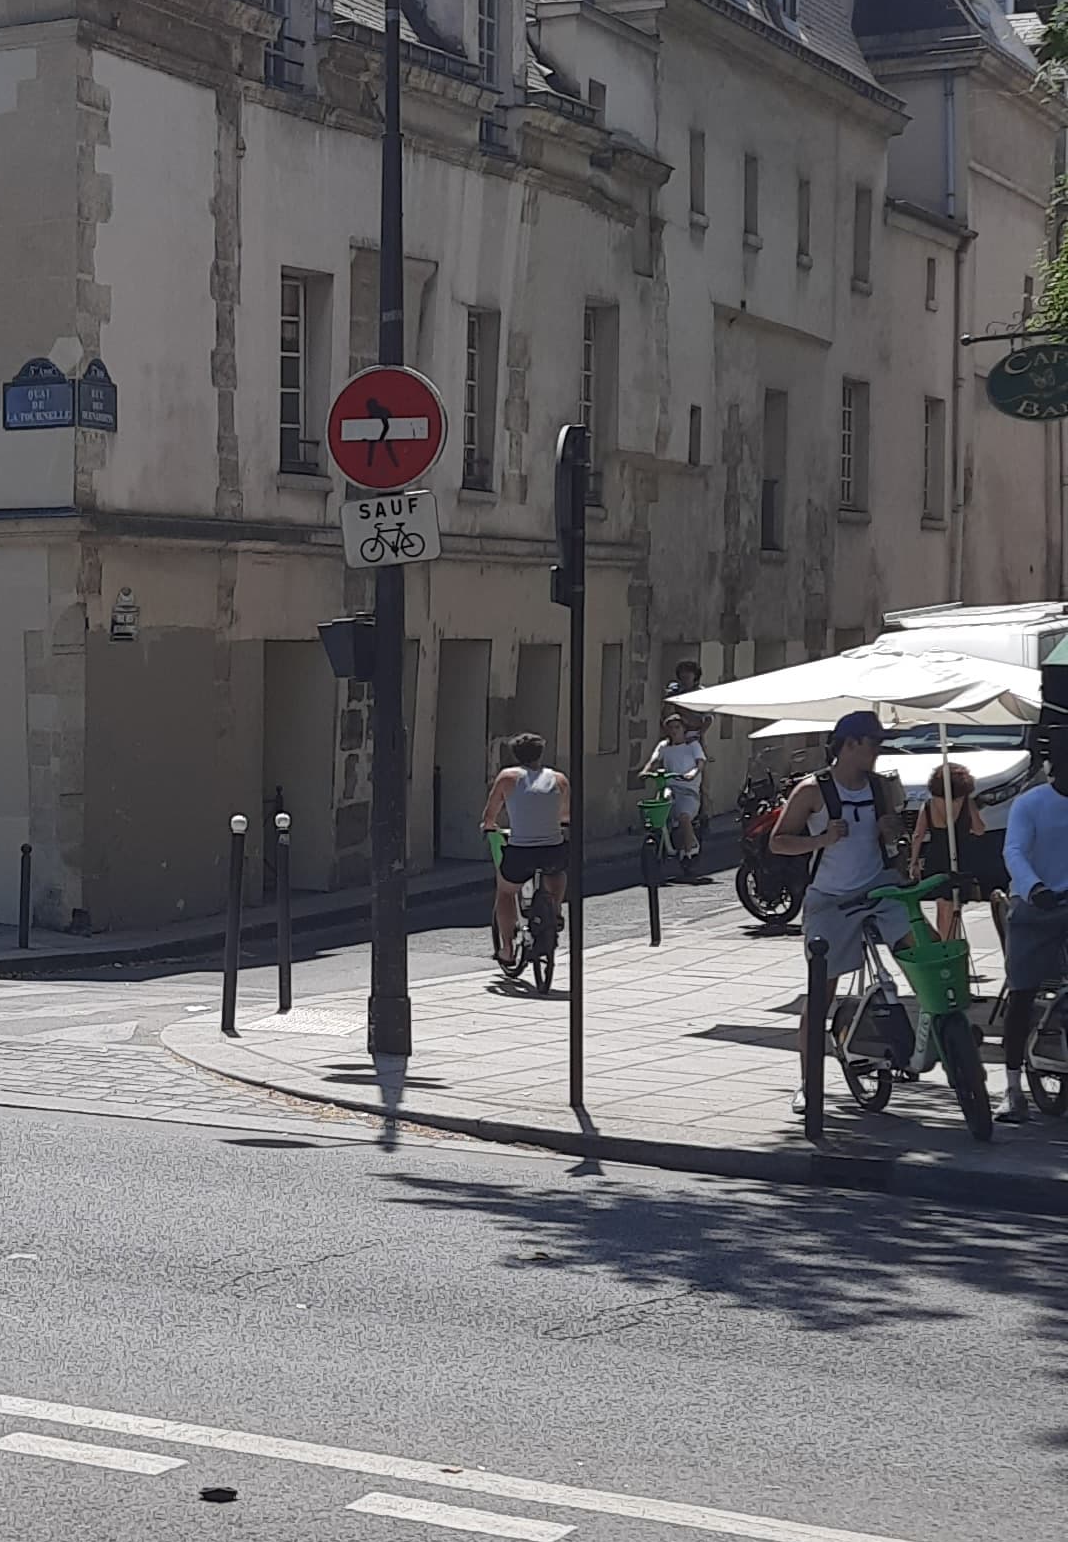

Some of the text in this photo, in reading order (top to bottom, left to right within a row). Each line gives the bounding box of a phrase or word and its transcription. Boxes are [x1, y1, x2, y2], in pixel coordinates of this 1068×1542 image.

[27, 389, 50, 400] QUAI
[32, 401, 45, 410] DE
[6, 412, 19, 422] LA
[20, 410, 71, 421] TOURNELLE
[358, 497, 419, 520] SAUF
